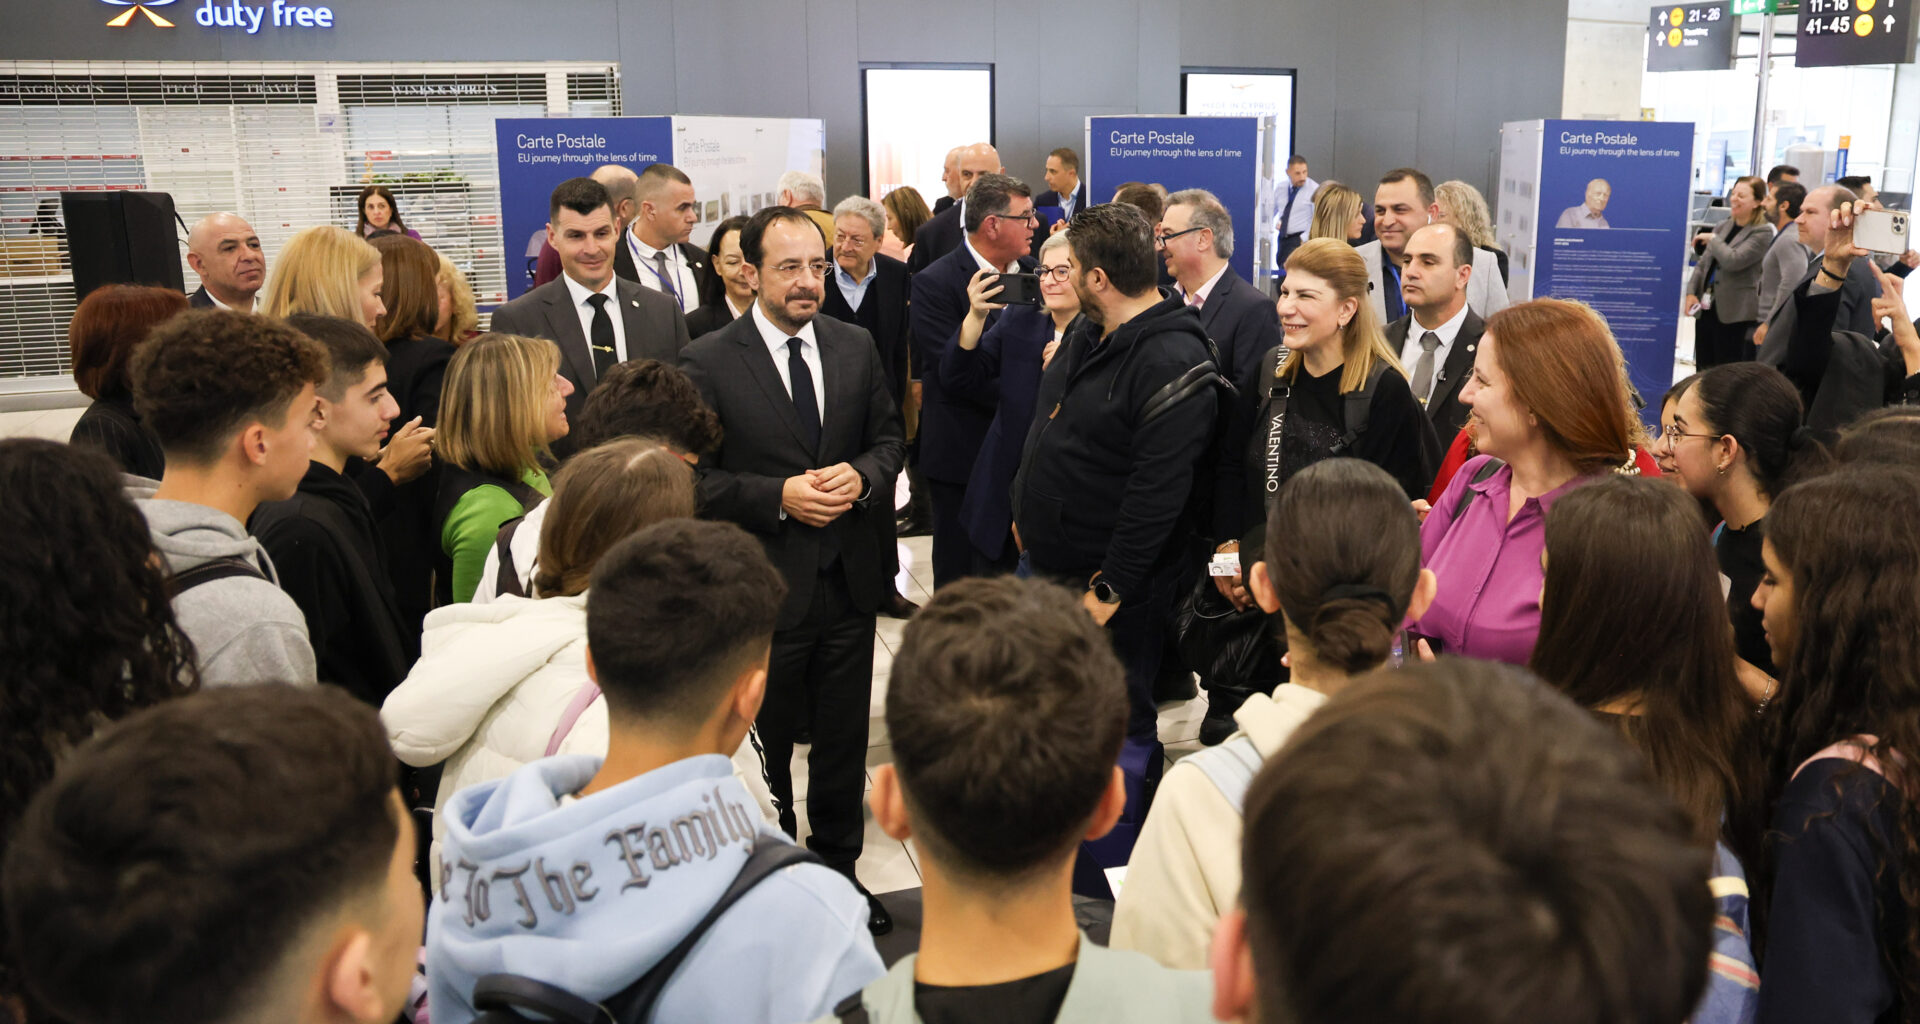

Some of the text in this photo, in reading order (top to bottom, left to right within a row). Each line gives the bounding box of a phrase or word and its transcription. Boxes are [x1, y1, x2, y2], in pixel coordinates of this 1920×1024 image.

[195, 0, 334, 34] duty free
[1805, 16, 1850, 35] 41-45
[517, 133, 606, 149] Carte Postale
[1110, 130, 1195, 145] Carte Postale
[1560, 131, 1638, 145] Carte Postale
[518, 152, 657, 165] EU journey through the lens of time
[1110, 147, 1242, 159] EU journey through the lens of time
[1560, 146, 1680, 158] EU journey through the lens of time
[1266, 412, 1284, 493] VALENTINO
[457, 857, 491, 929] To
[491, 856, 600, 930] The
[604, 785, 756, 895] Family
